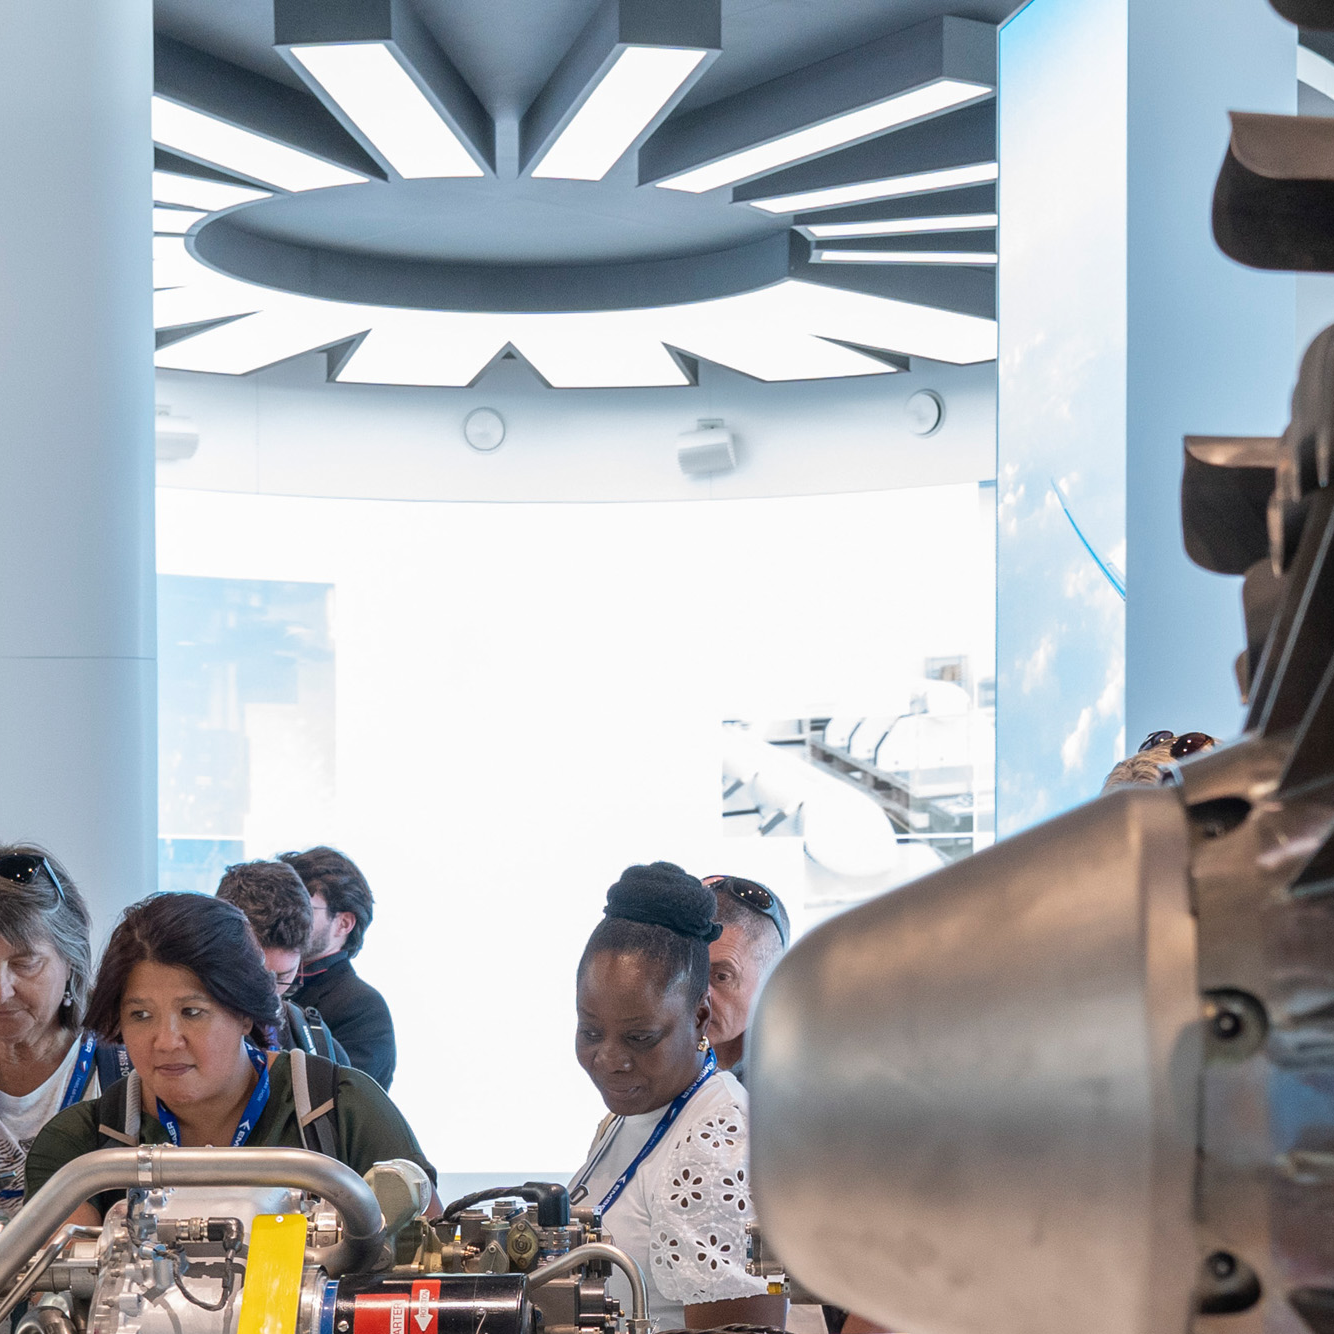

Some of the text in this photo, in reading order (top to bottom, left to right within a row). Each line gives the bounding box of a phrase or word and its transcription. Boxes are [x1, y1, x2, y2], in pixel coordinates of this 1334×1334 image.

[84, 1036, 94, 1053] AER
[681, 1062, 714, 1099] EMBRAER
[420, 1290, 429, 1318] ROTATION
